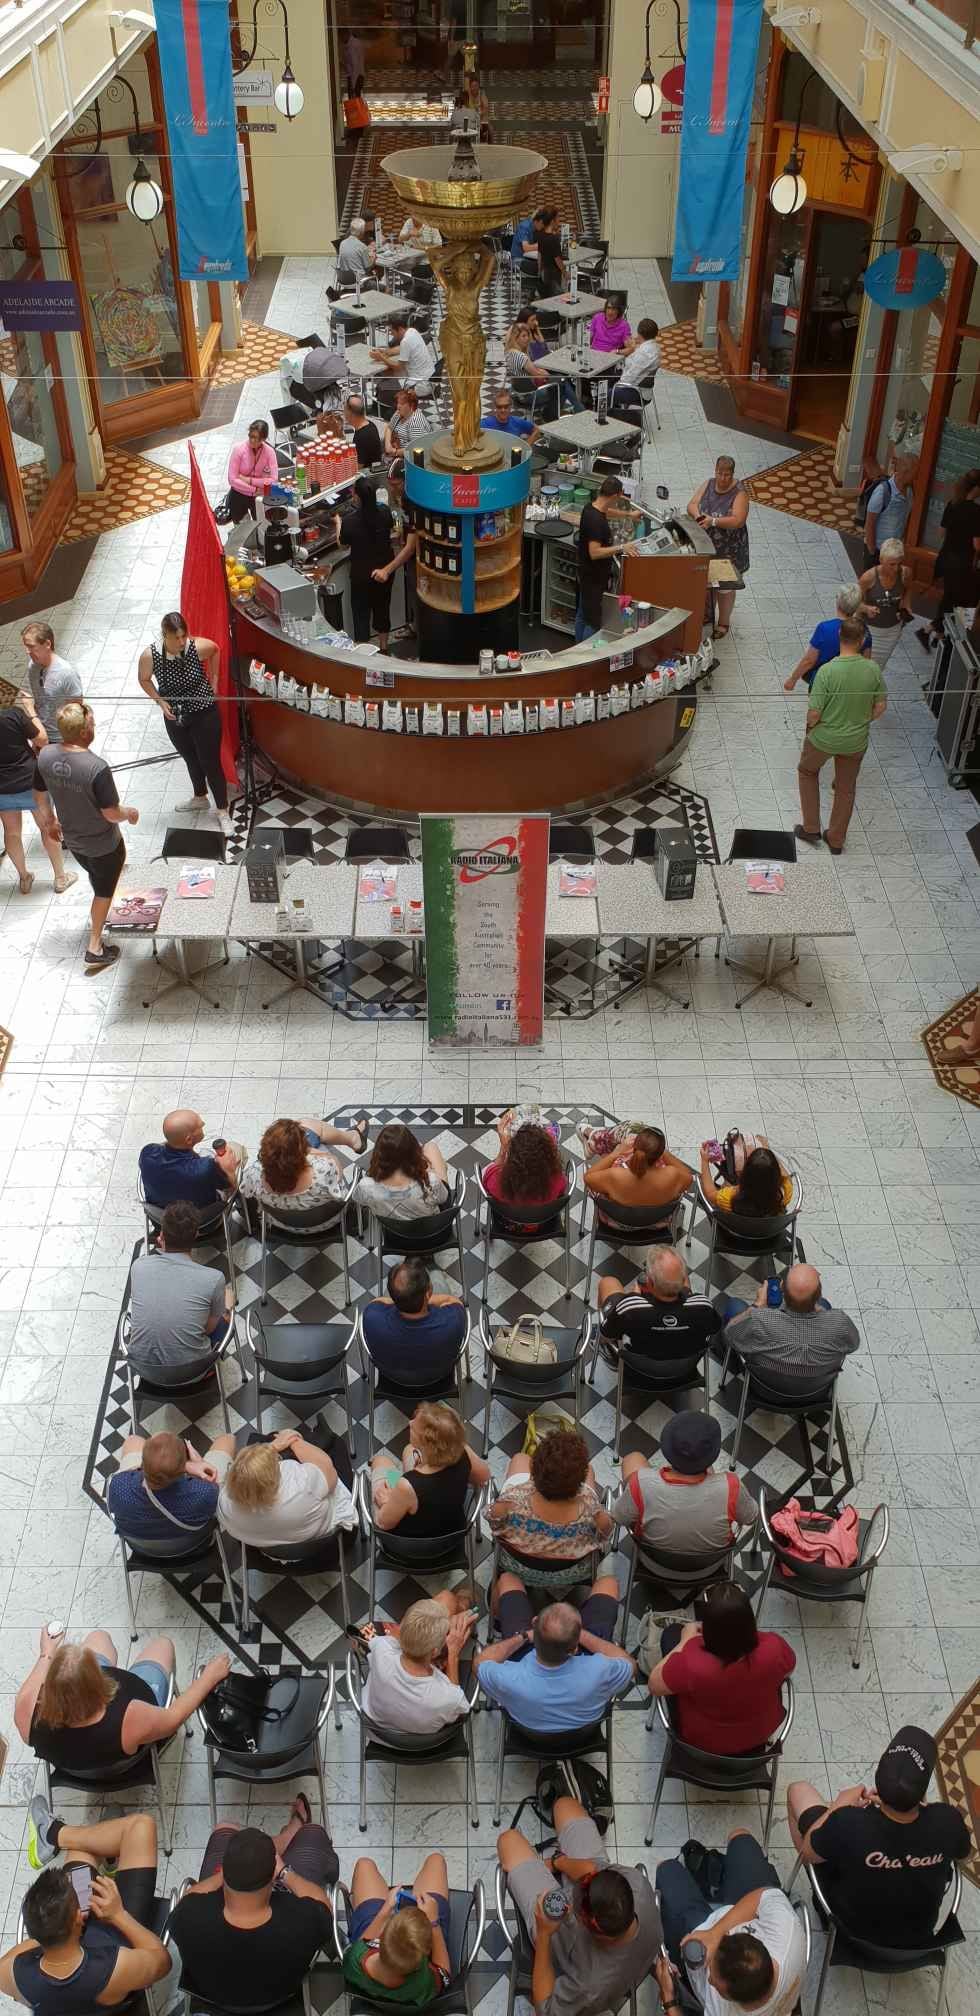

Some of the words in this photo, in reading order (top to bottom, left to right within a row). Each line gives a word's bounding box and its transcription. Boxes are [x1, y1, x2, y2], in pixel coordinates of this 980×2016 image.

[3, 297, 42, 306] ADELAIDE
[44, 297, 74, 307] ARCADE
[451, 856, 478, 864] RADIO
[480, 856, 519, 864] ITALIANA
[473, 942, 504, 950] Community
